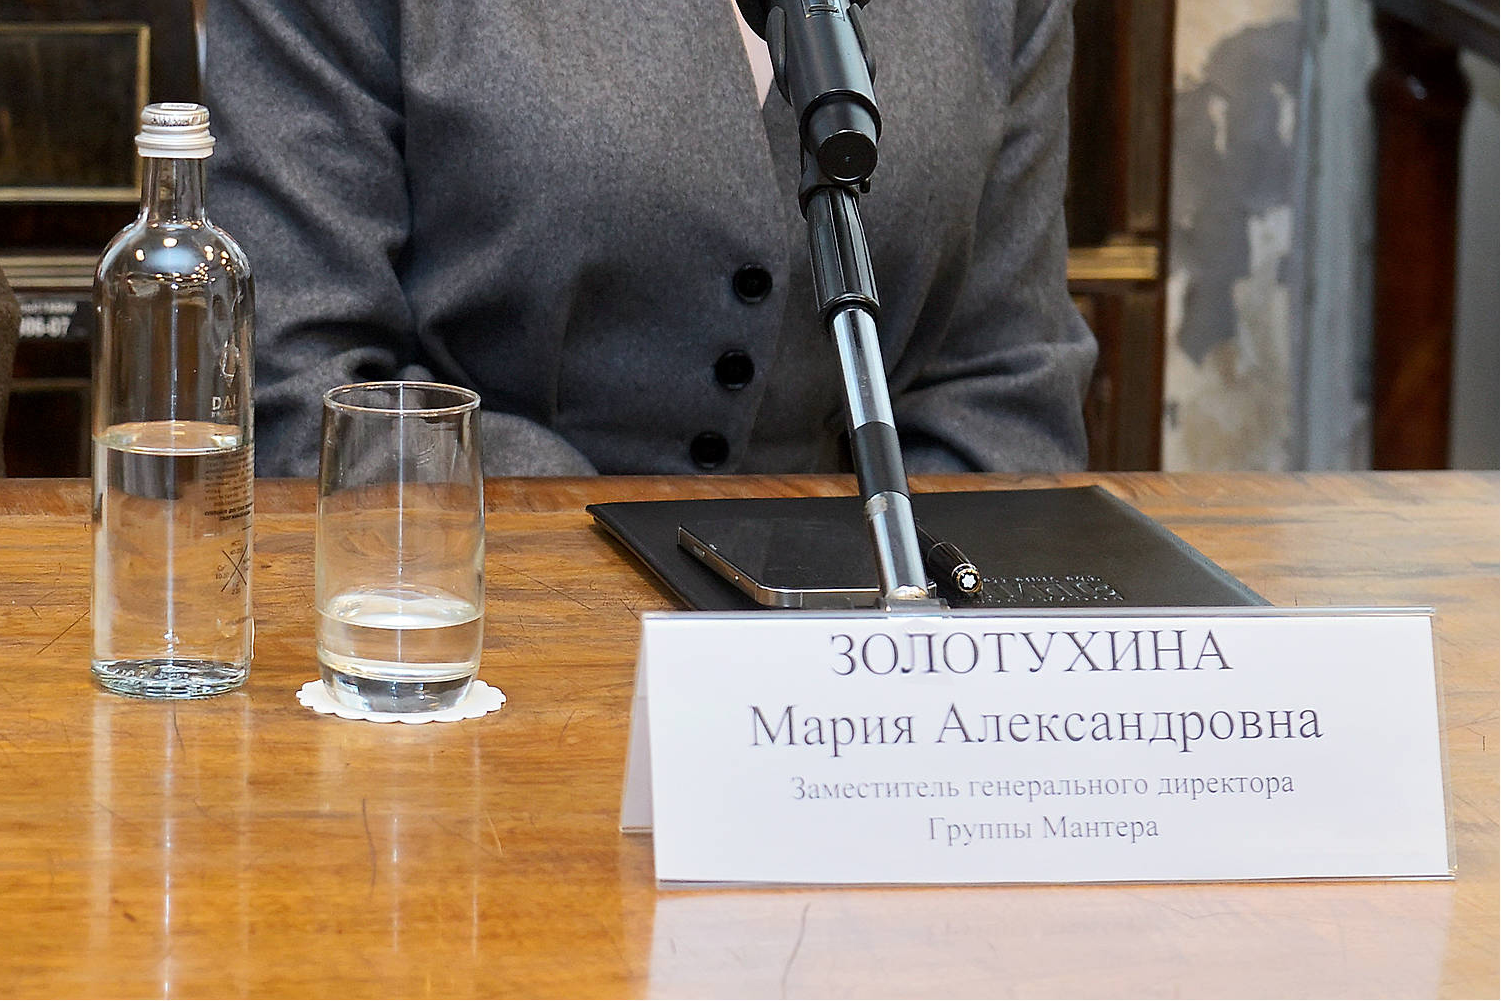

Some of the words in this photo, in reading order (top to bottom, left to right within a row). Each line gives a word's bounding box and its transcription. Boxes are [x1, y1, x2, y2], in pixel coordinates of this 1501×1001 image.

[830, 629, 1235, 676] ЗОЛОТУХИНА
[748, 704, 917, 758] Мария
[933, 702, 1325, 754] Александровна
[791, 775, 961, 800] Заместитель
[968, 776, 1149, 803] генерального
[1156, 774, 1296, 800] директора
[928, 815, 1032, 847] Группы
[1041, 815, 1160, 843] Мантера
